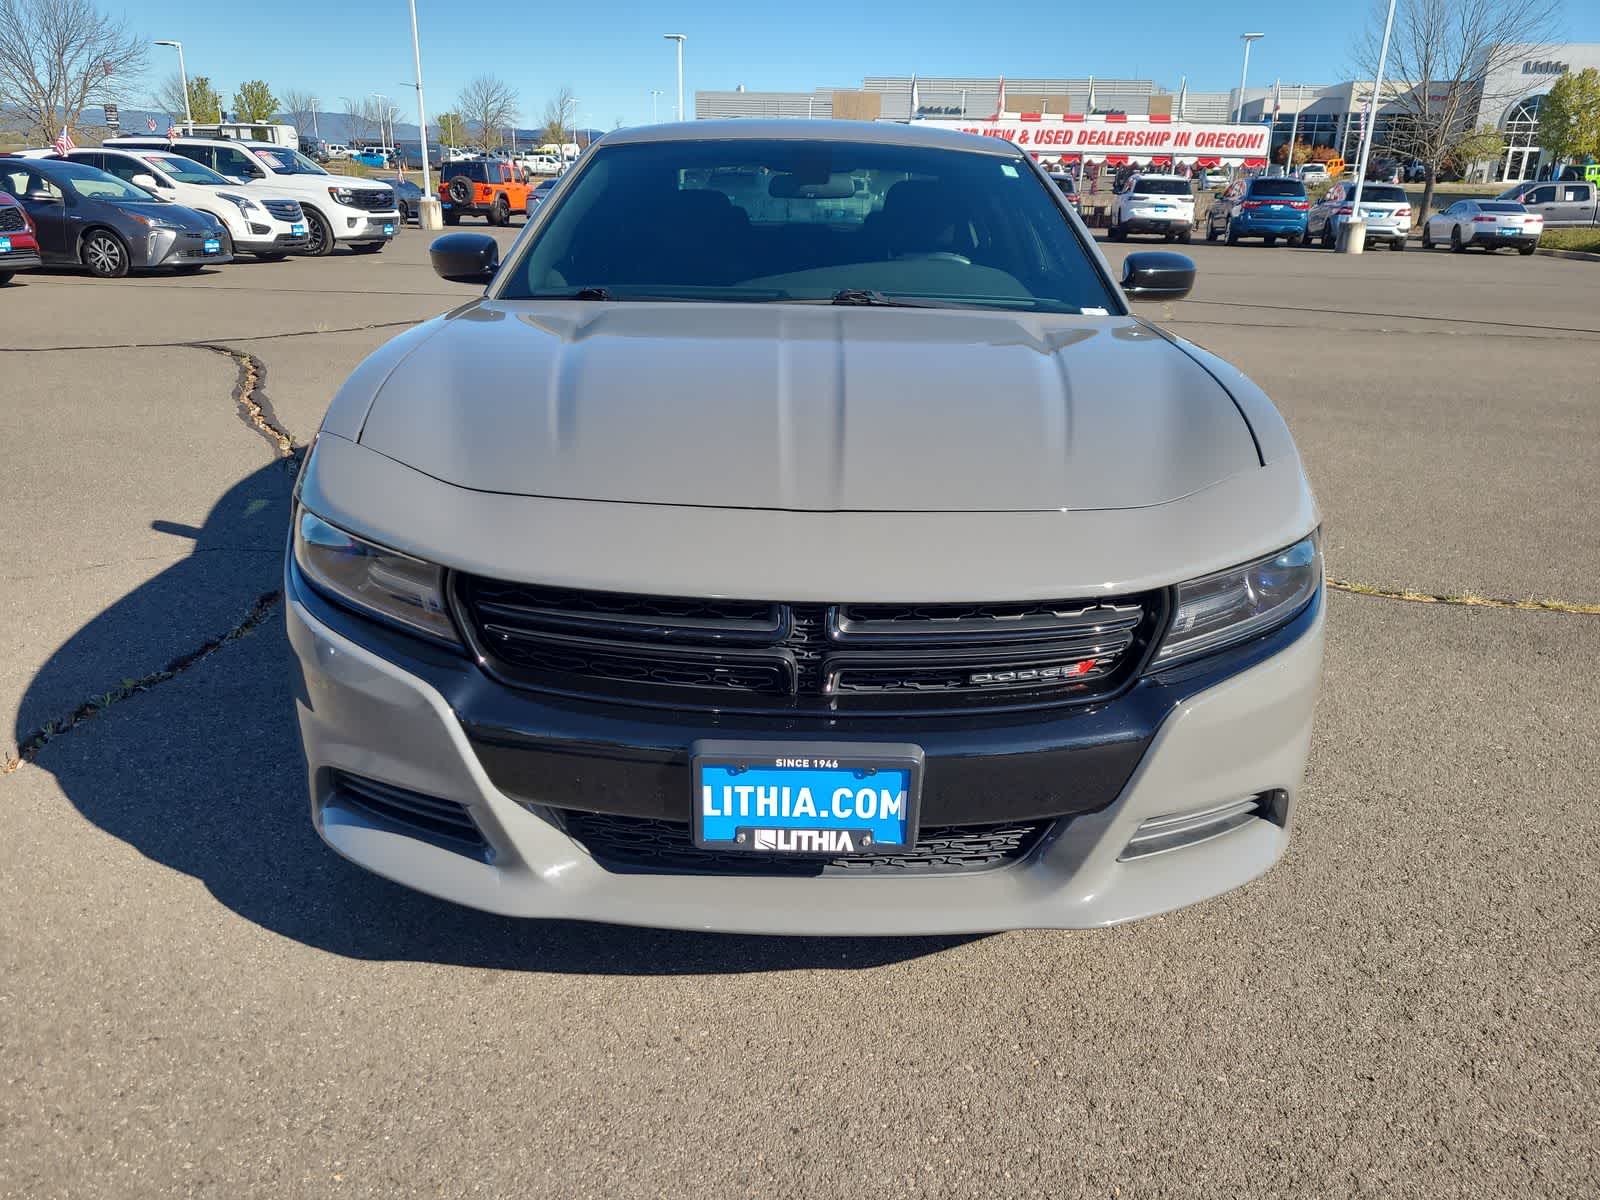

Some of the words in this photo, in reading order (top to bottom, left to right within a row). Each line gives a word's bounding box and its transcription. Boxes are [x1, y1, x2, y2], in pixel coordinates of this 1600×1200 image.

[1019, 130, 1030, 145] &
[1034, 130, 1074, 145] USED
[1077, 130, 1171, 147] DEALERSHIP
[1174, 131, 1192, 147] IN
[1195, 132, 1264, 149] OREGON!
[970, 664, 1077, 684] DODGE
[775, 758, 810, 768] SINCE
[813, 759, 839, 769] 1946
[703, 785, 907, 821] LITHIA.COM
[778, 830, 854, 852] LITHIA
